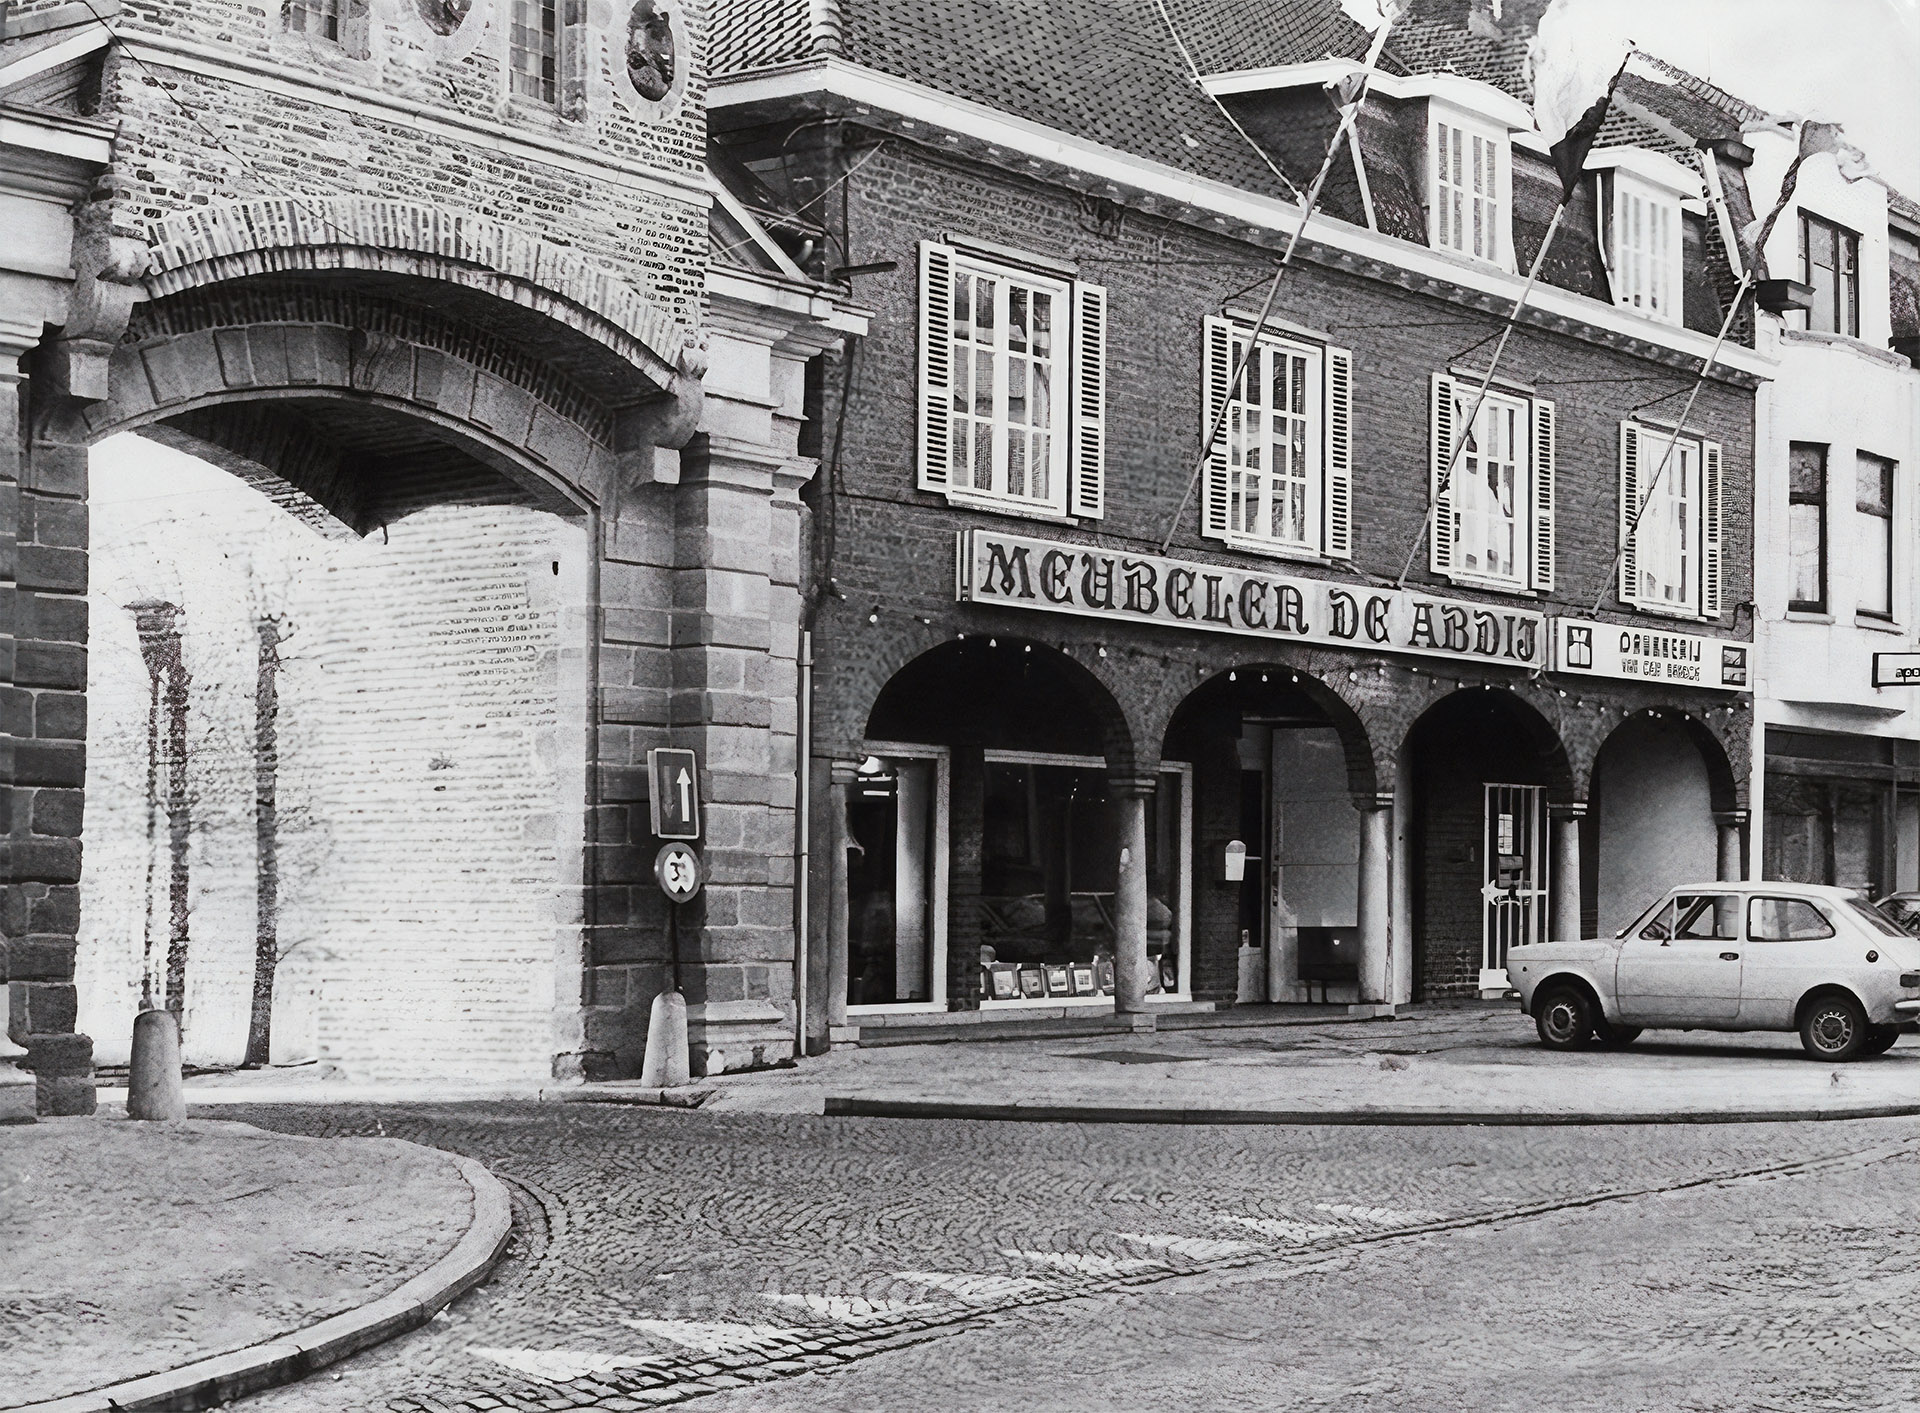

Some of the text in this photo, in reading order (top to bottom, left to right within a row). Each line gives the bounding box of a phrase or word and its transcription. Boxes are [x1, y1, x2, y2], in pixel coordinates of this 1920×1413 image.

[980, 542, 1539, 661] MEUBELEN DE ABDIJ
